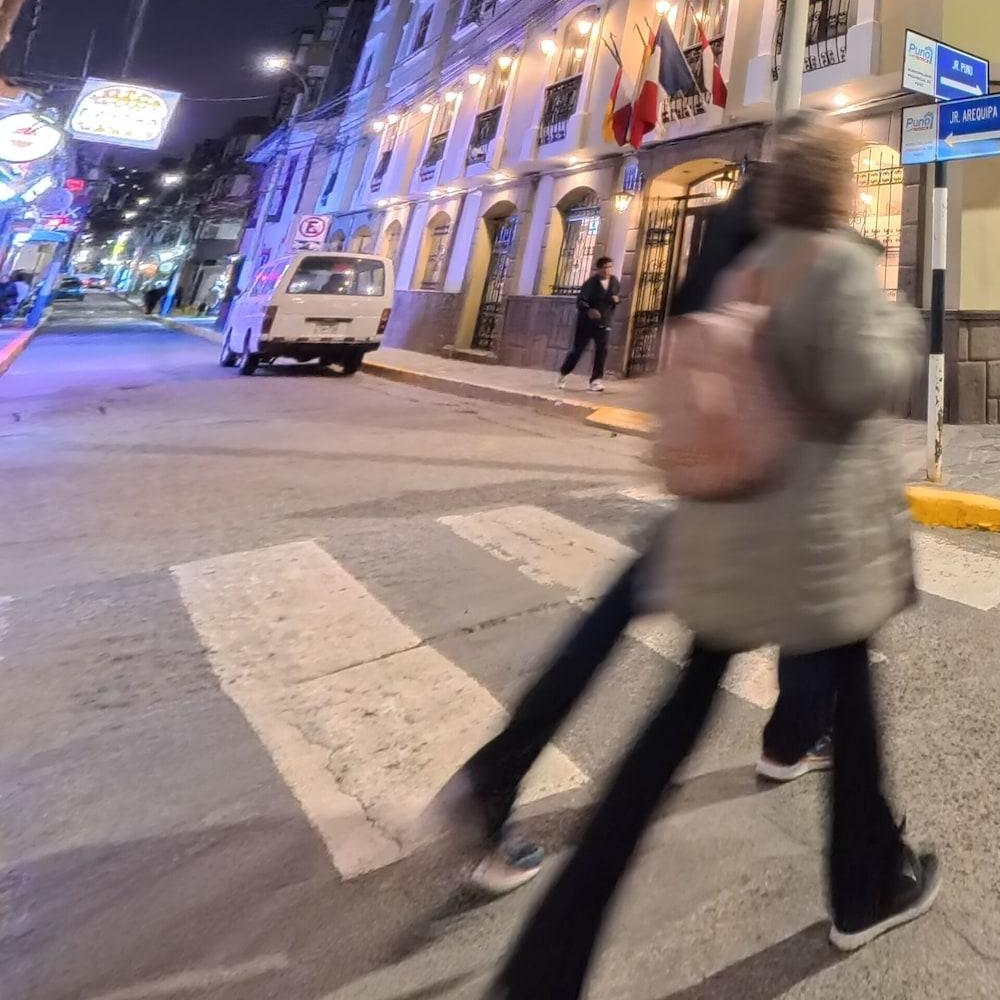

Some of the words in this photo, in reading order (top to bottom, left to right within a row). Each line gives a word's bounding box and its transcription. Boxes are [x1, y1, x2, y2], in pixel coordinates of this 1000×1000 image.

[949, 110, 961, 124] JR.
[962, 105, 998, 123] AREQUIPA
[305, 220, 319, 234] E
